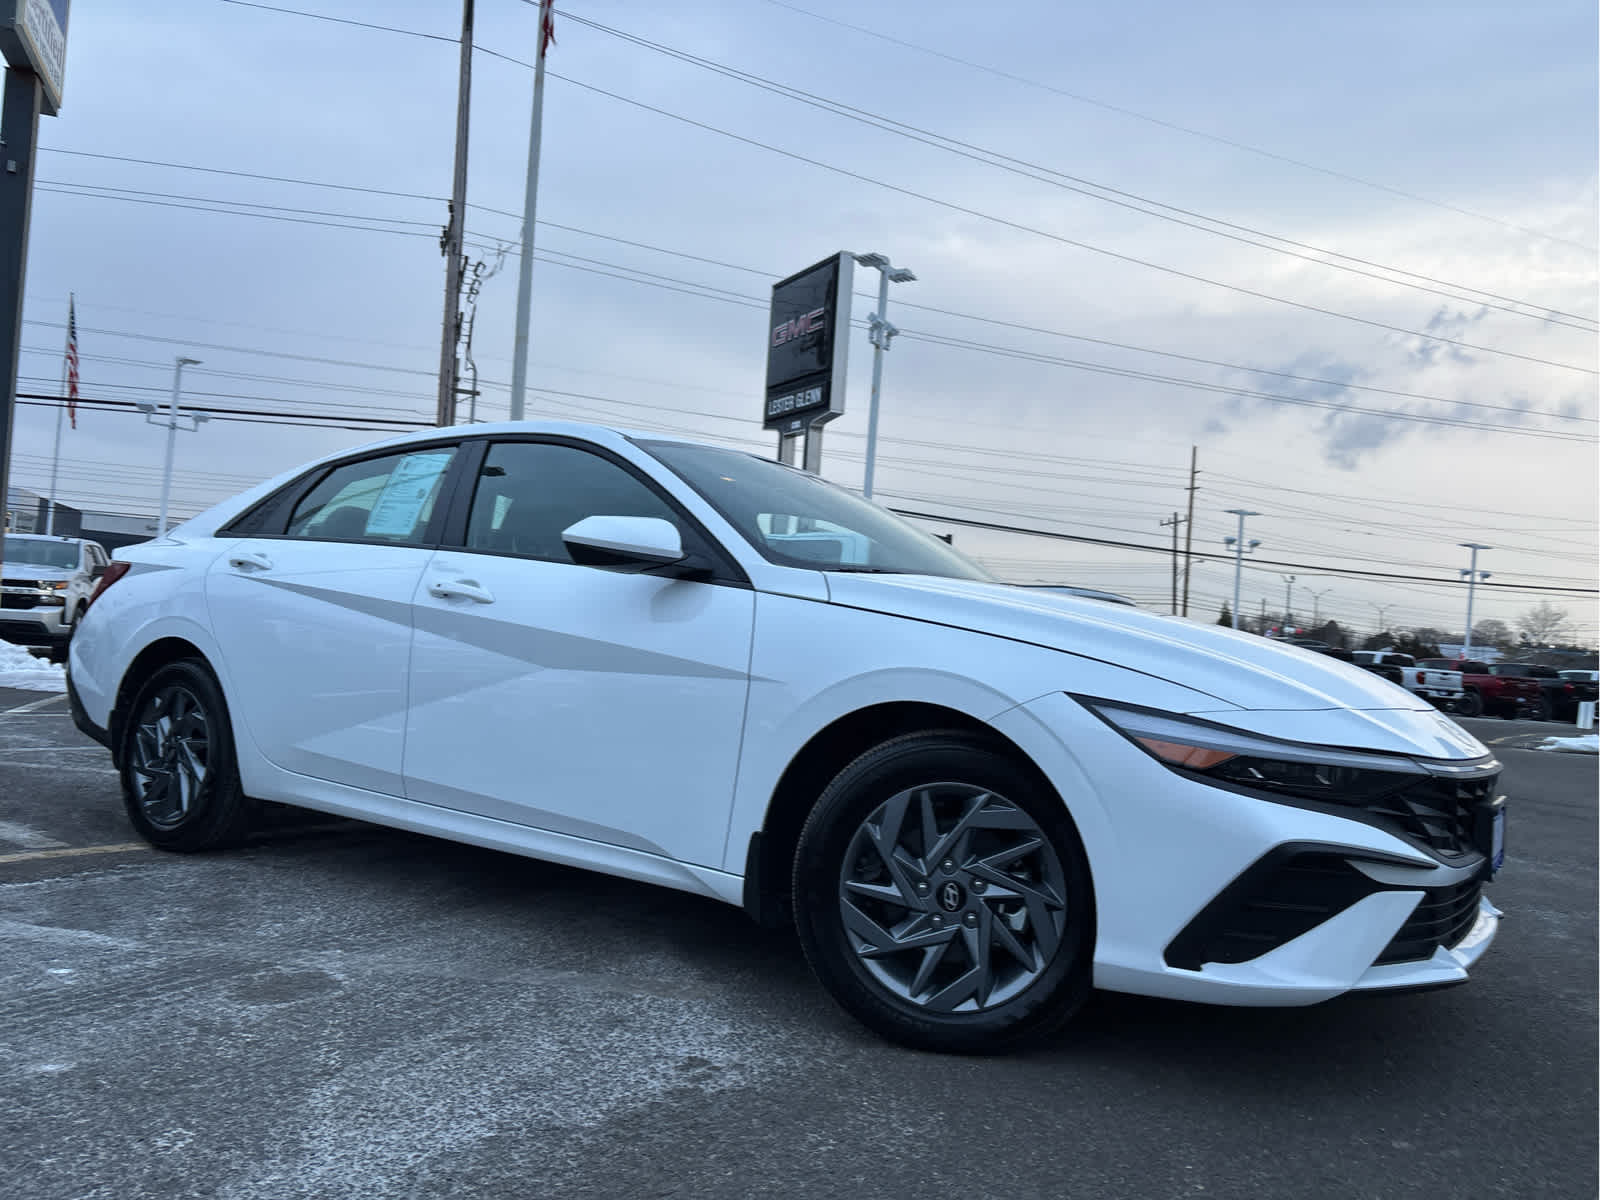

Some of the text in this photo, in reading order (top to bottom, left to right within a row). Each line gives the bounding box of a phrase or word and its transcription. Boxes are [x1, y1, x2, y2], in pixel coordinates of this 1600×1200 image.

[772, 307, 825, 347] GMC
[768, 387, 822, 415] LESTER GLENN
